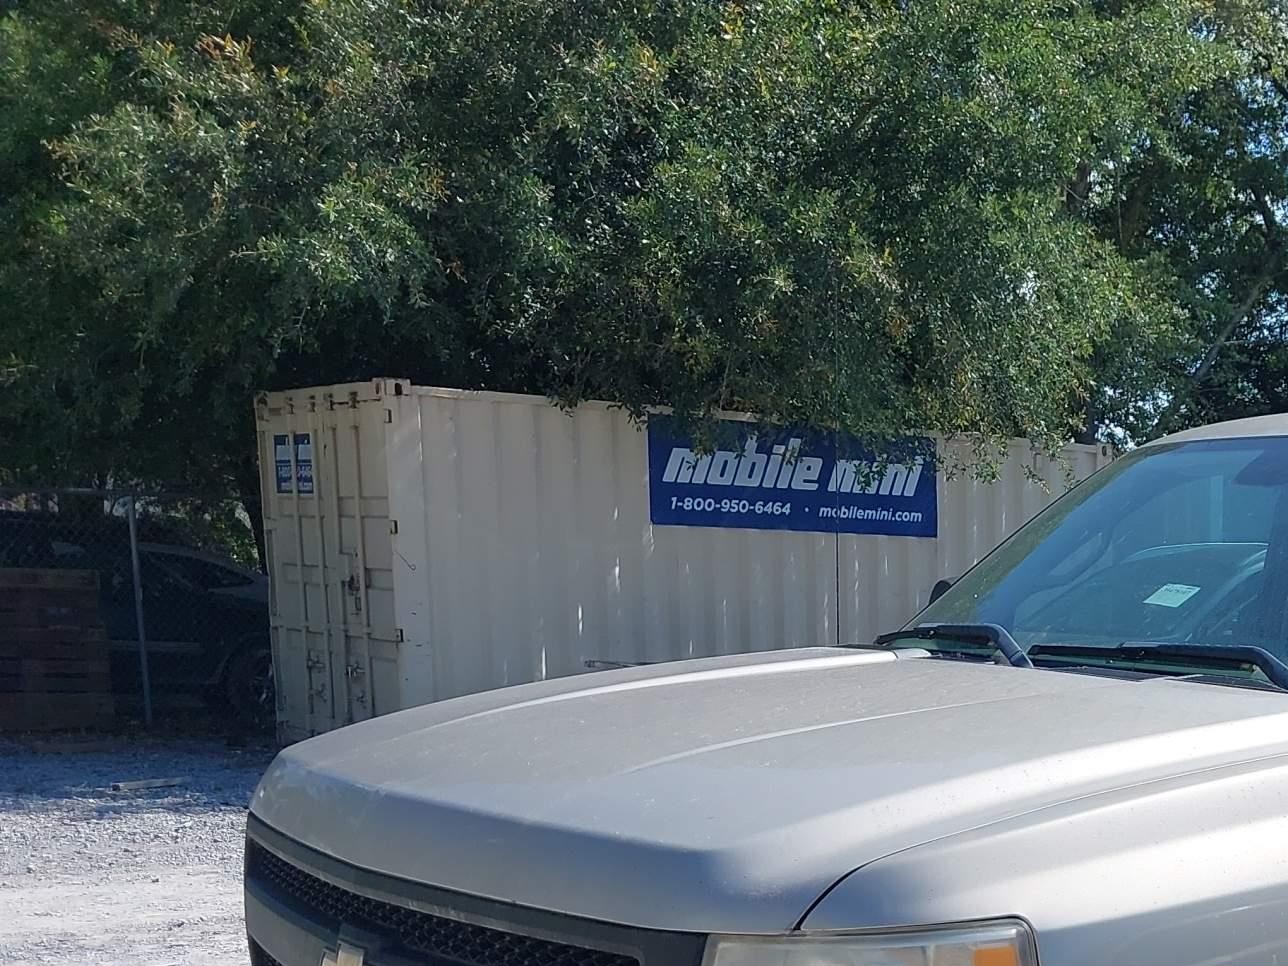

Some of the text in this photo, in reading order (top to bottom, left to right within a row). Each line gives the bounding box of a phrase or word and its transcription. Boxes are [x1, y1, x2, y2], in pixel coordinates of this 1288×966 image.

[662, 436, 823, 491] mobile
[670, 496, 923, 523] 1-800-950-6464 mobilemini.com
